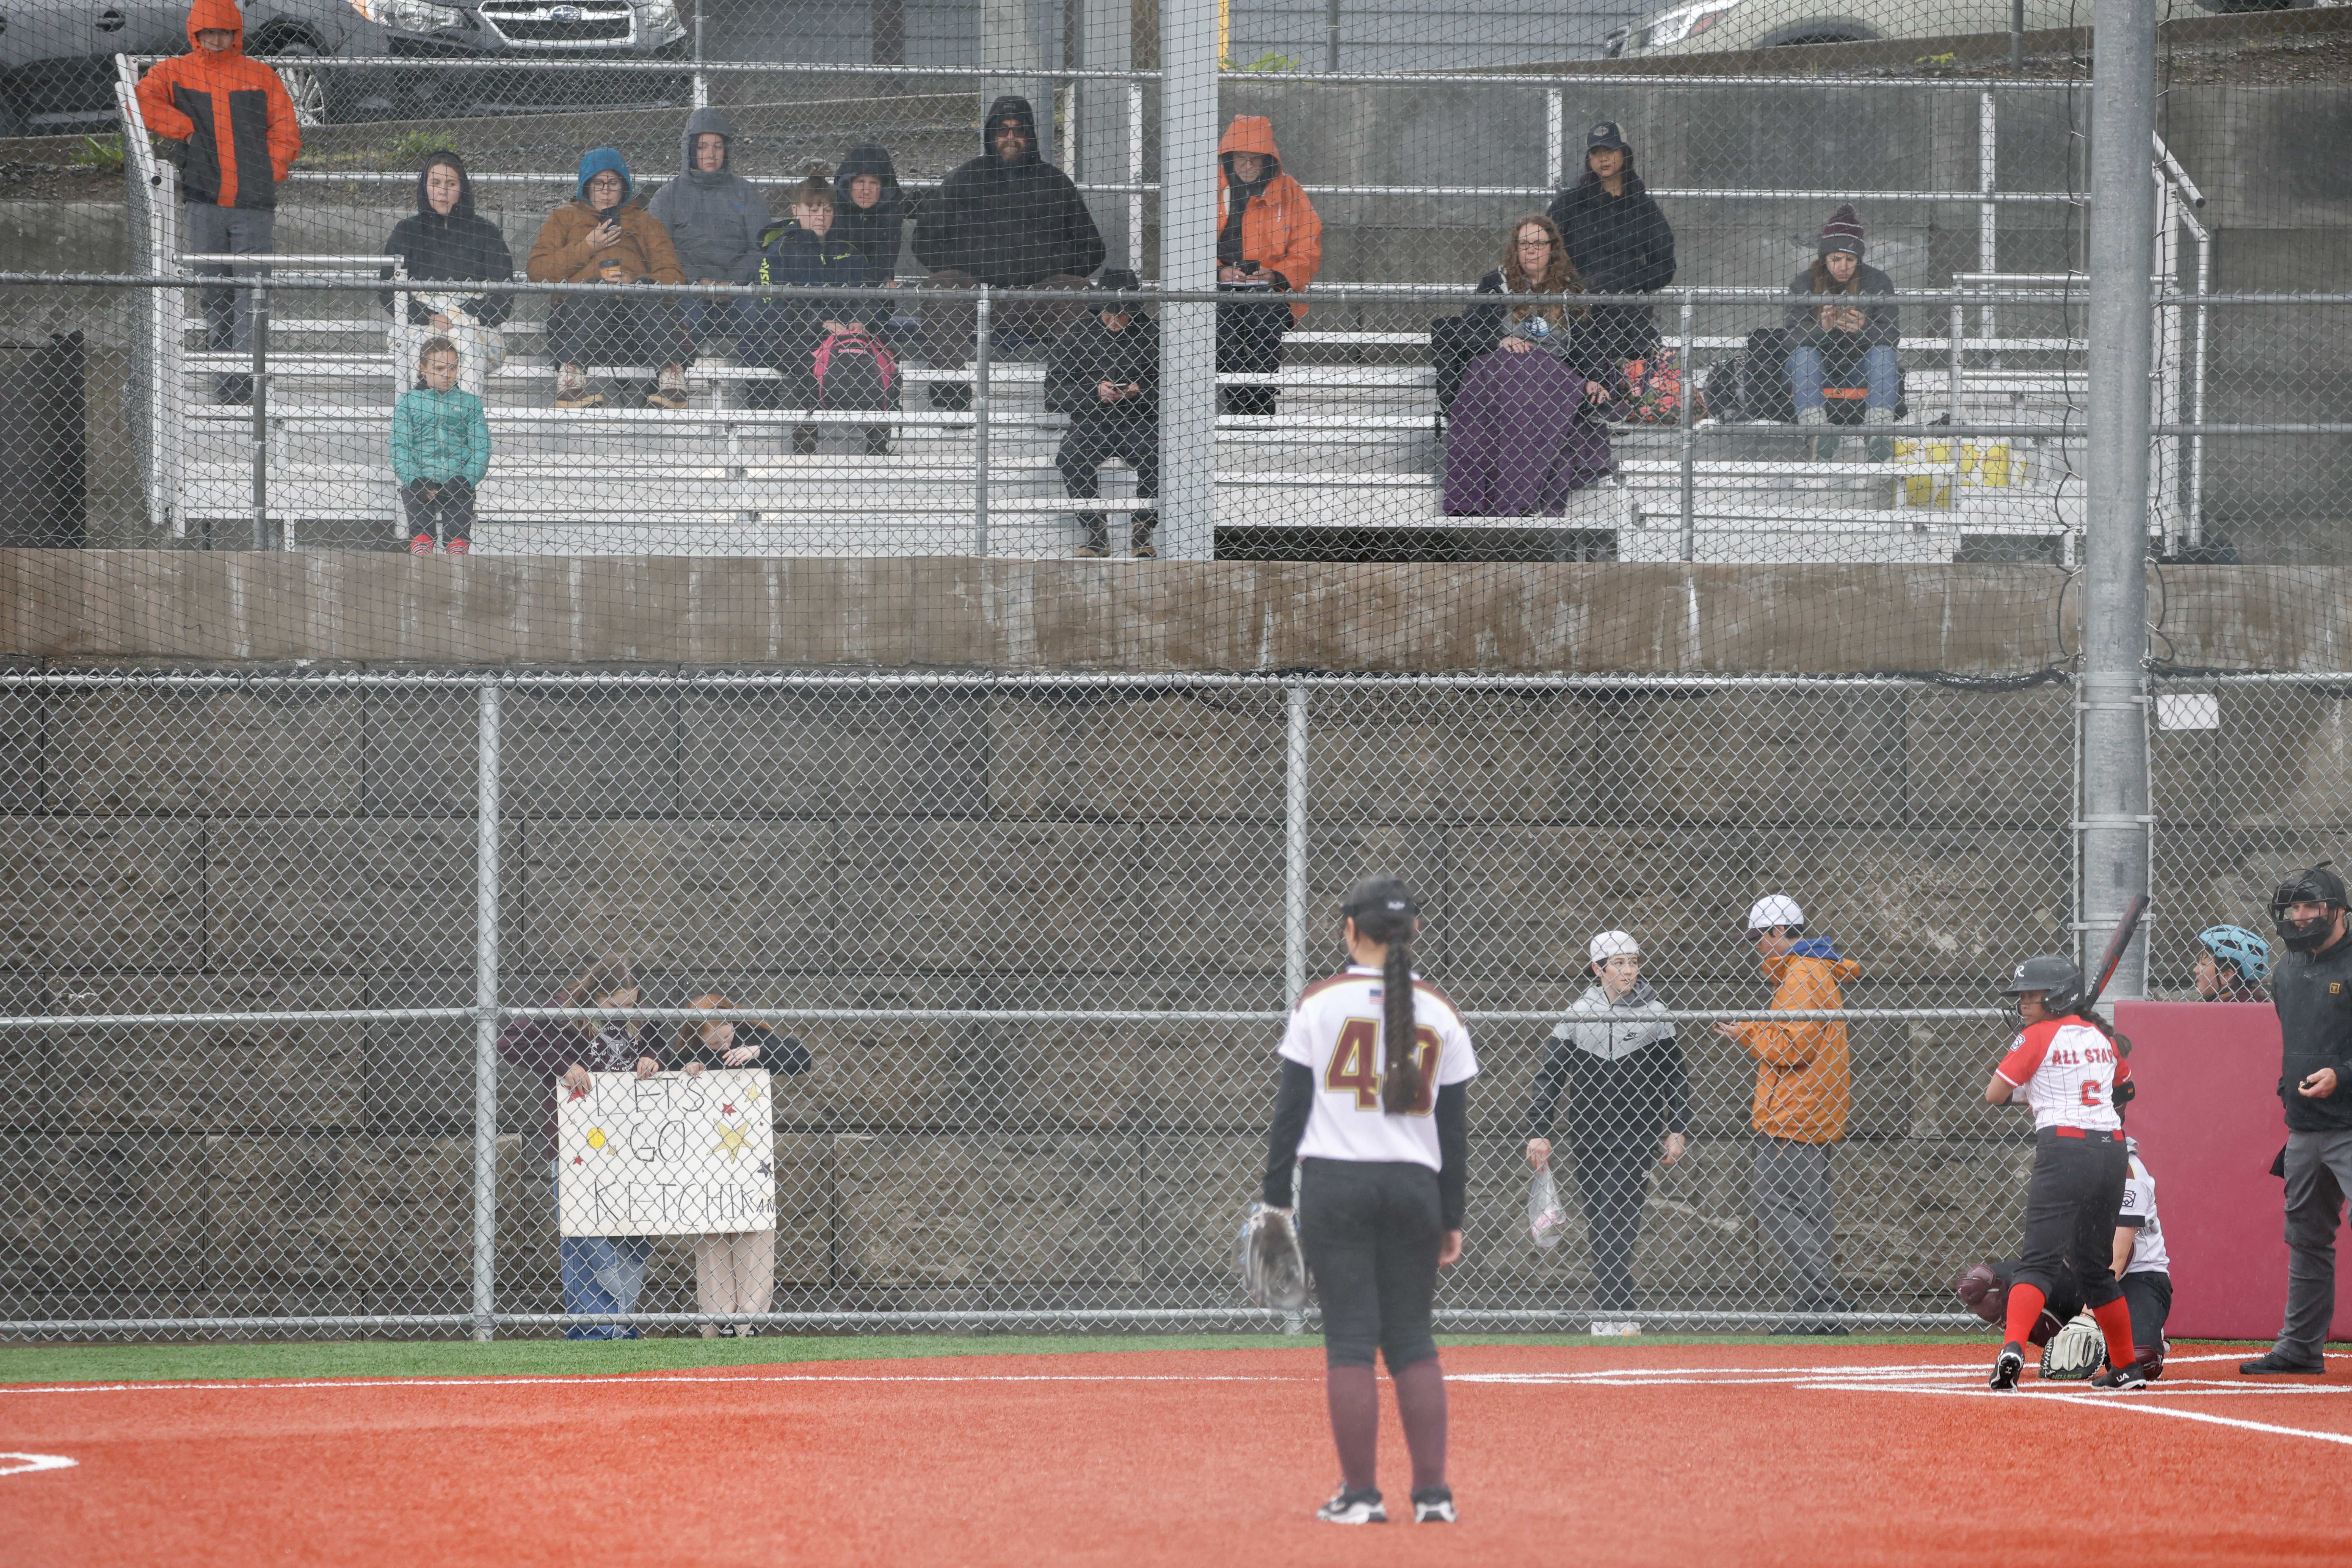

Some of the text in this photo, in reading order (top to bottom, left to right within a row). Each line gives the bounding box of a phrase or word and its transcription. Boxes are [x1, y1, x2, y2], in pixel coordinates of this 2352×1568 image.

[615, 1043, 623, 1054] K
[2052, 1050, 2080, 1065] ALL
[595, 1073, 704, 1116] LET'S
[630, 1120, 686, 1162] GO
[595, 1179, 775, 1227] KETCHIKAN
[2116, 1372, 2129, 1383] UA
